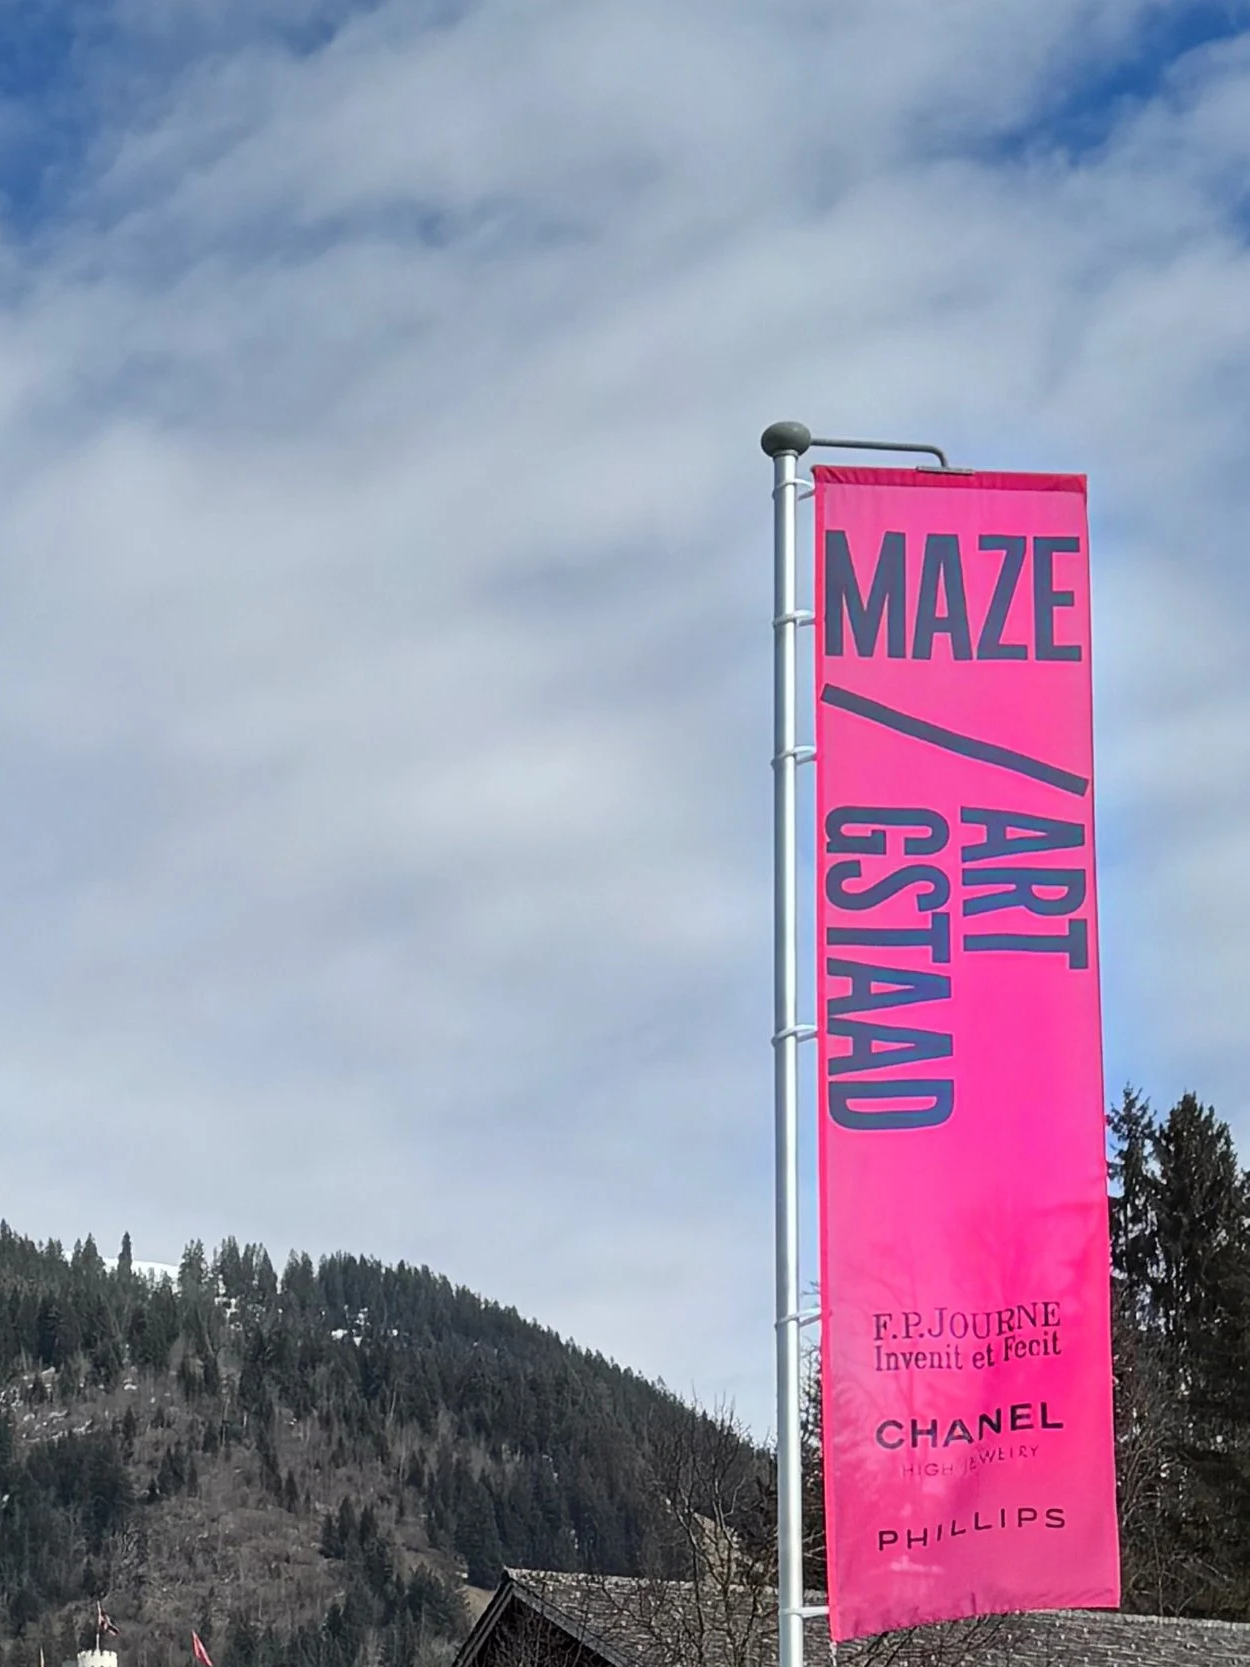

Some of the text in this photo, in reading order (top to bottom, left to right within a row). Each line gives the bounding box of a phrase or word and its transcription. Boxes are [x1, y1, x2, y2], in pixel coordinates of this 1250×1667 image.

[824, 529, 1082, 662] MAZE
[960, 805, 1088, 970] ART
[825, 804, 955, 1132] GSTAAD
[875, 1330, 1062, 1372] Invenit et Fecit
[875, 1401, 1064, 1450] CHANEL
[902, 1462, 954, 1478] HIGH
[878, 1507, 1066, 1552] PHILLIPS
